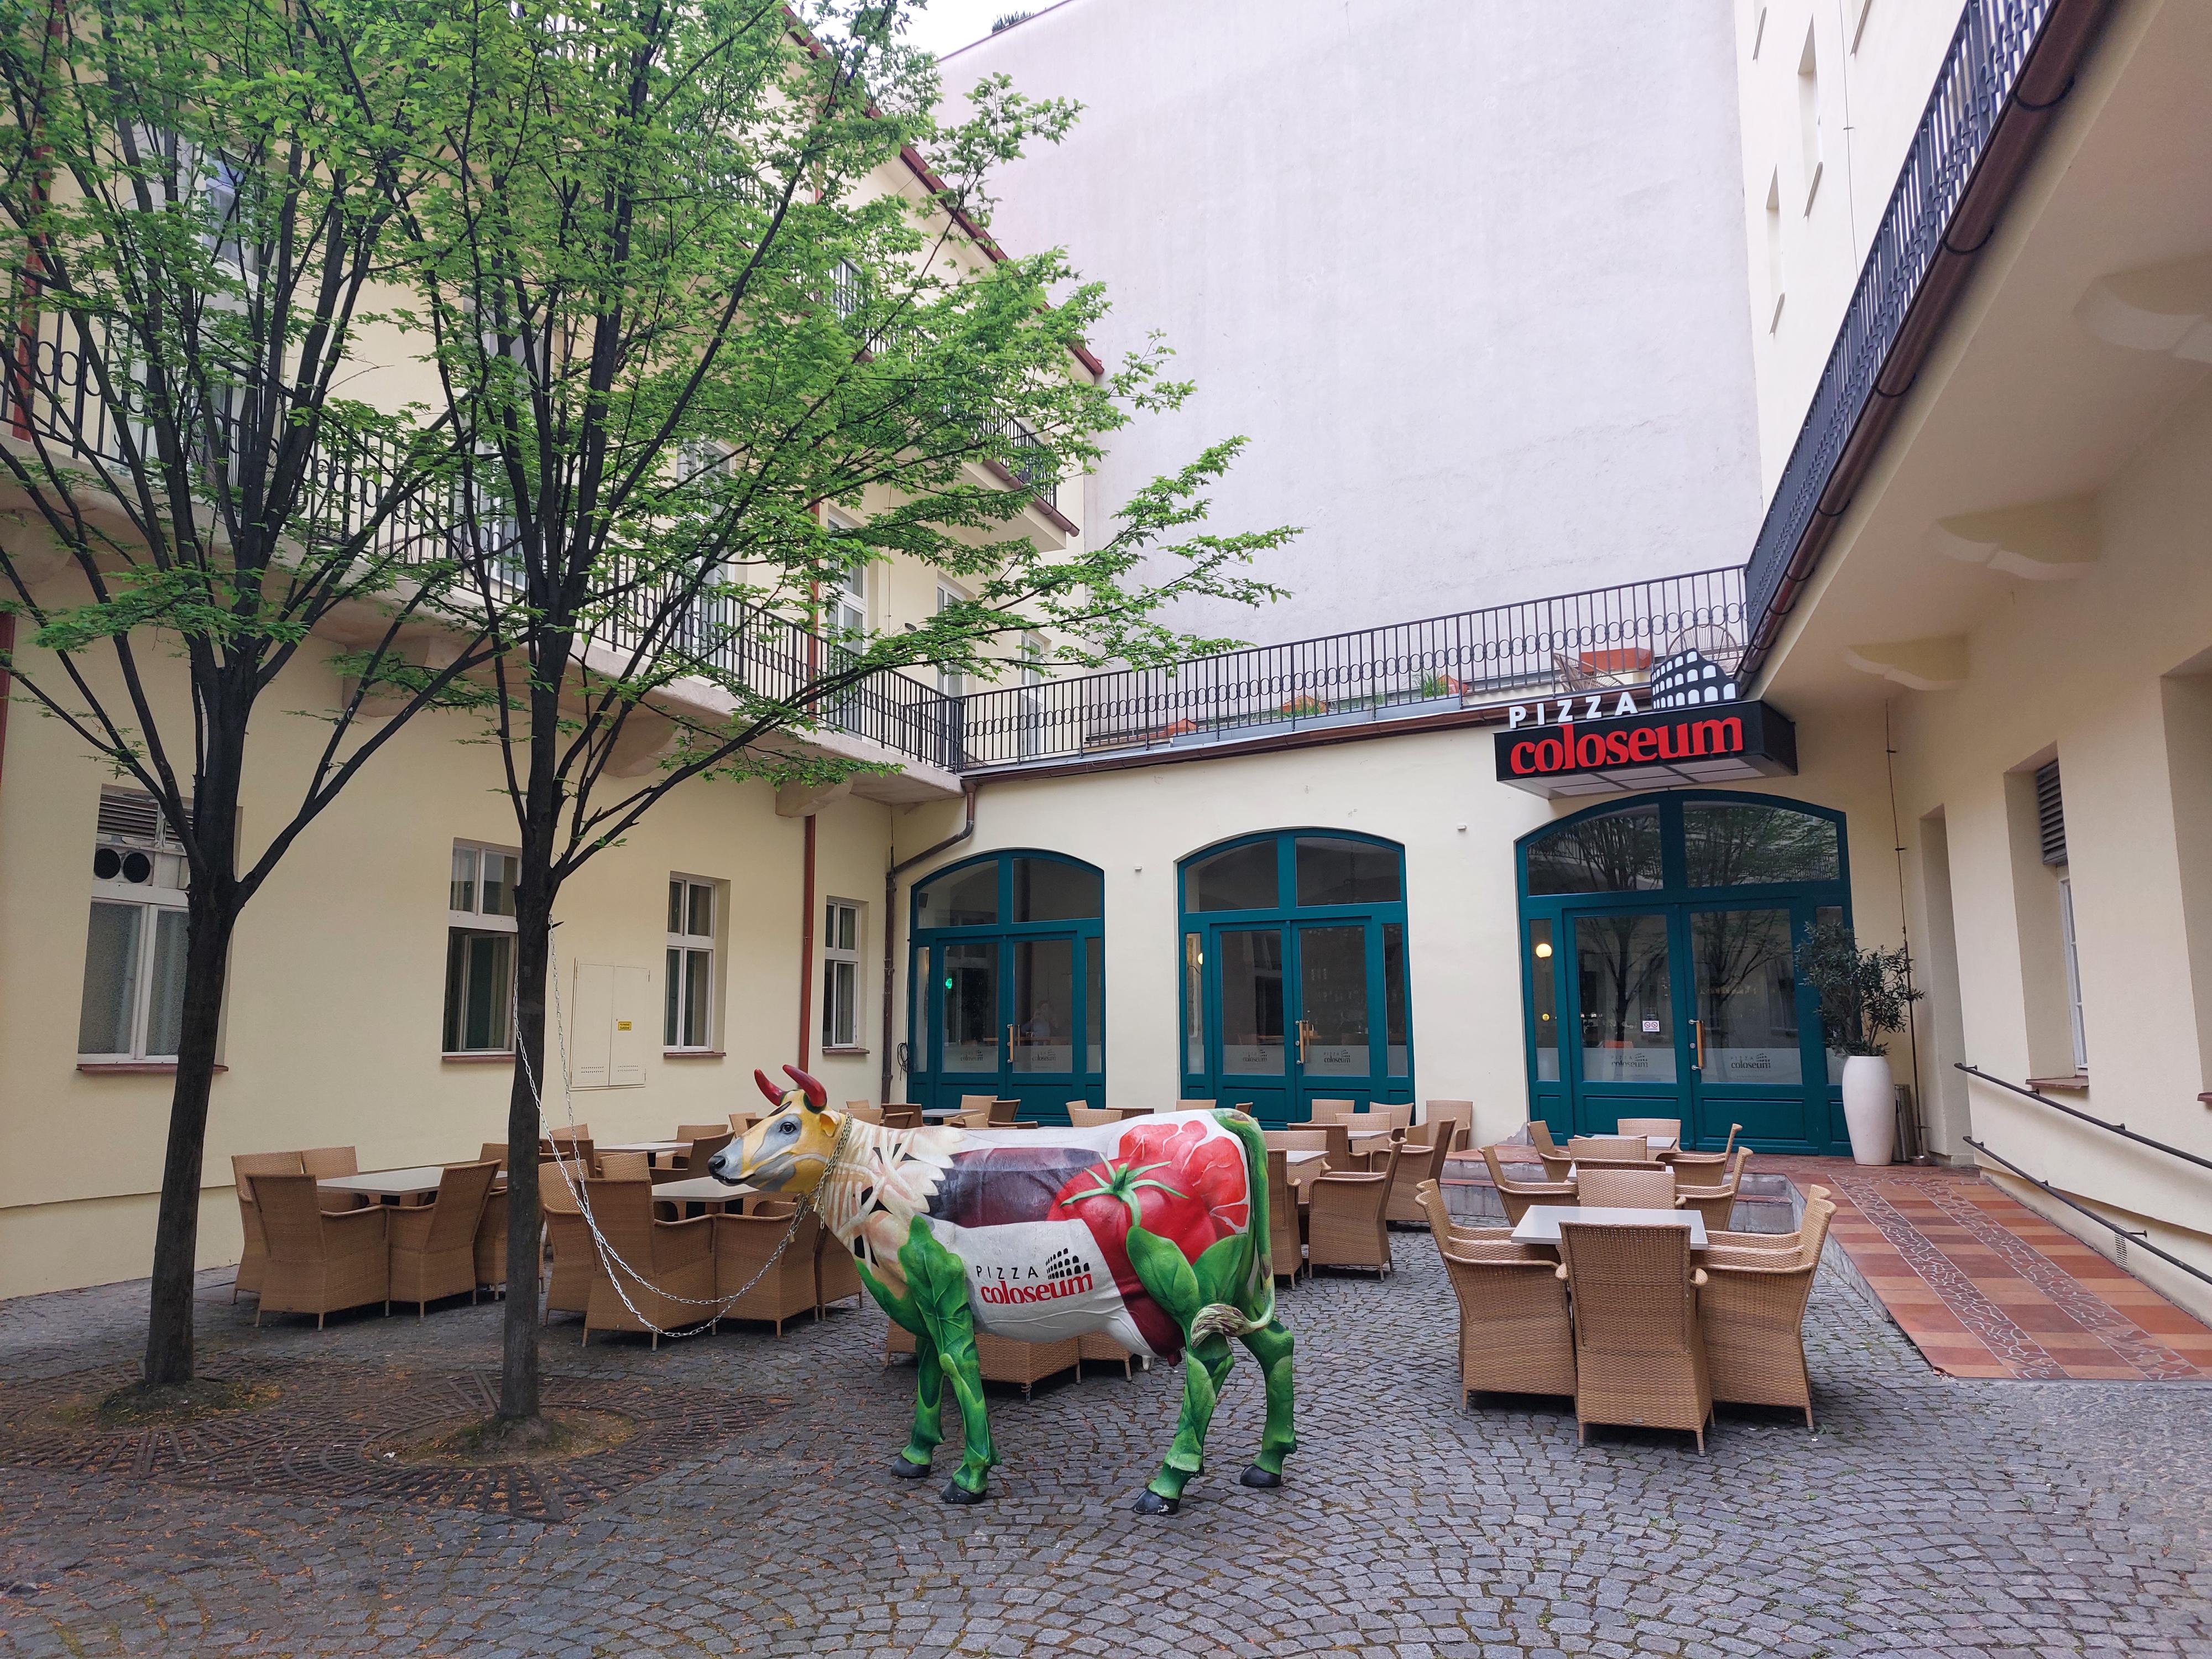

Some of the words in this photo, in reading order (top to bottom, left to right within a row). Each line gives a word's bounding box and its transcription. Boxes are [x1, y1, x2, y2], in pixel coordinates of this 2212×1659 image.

[1509, 691, 1639, 729] PIZZA
[1510, 717, 1744, 774] coloseum
[1324, 1055, 1350, 1063] coloseum
[1731, 1061, 1771, 1069] coloseum
[976, 1265, 1039, 1280] PIZZA
[981, 1274, 1093, 1305] coloseum
